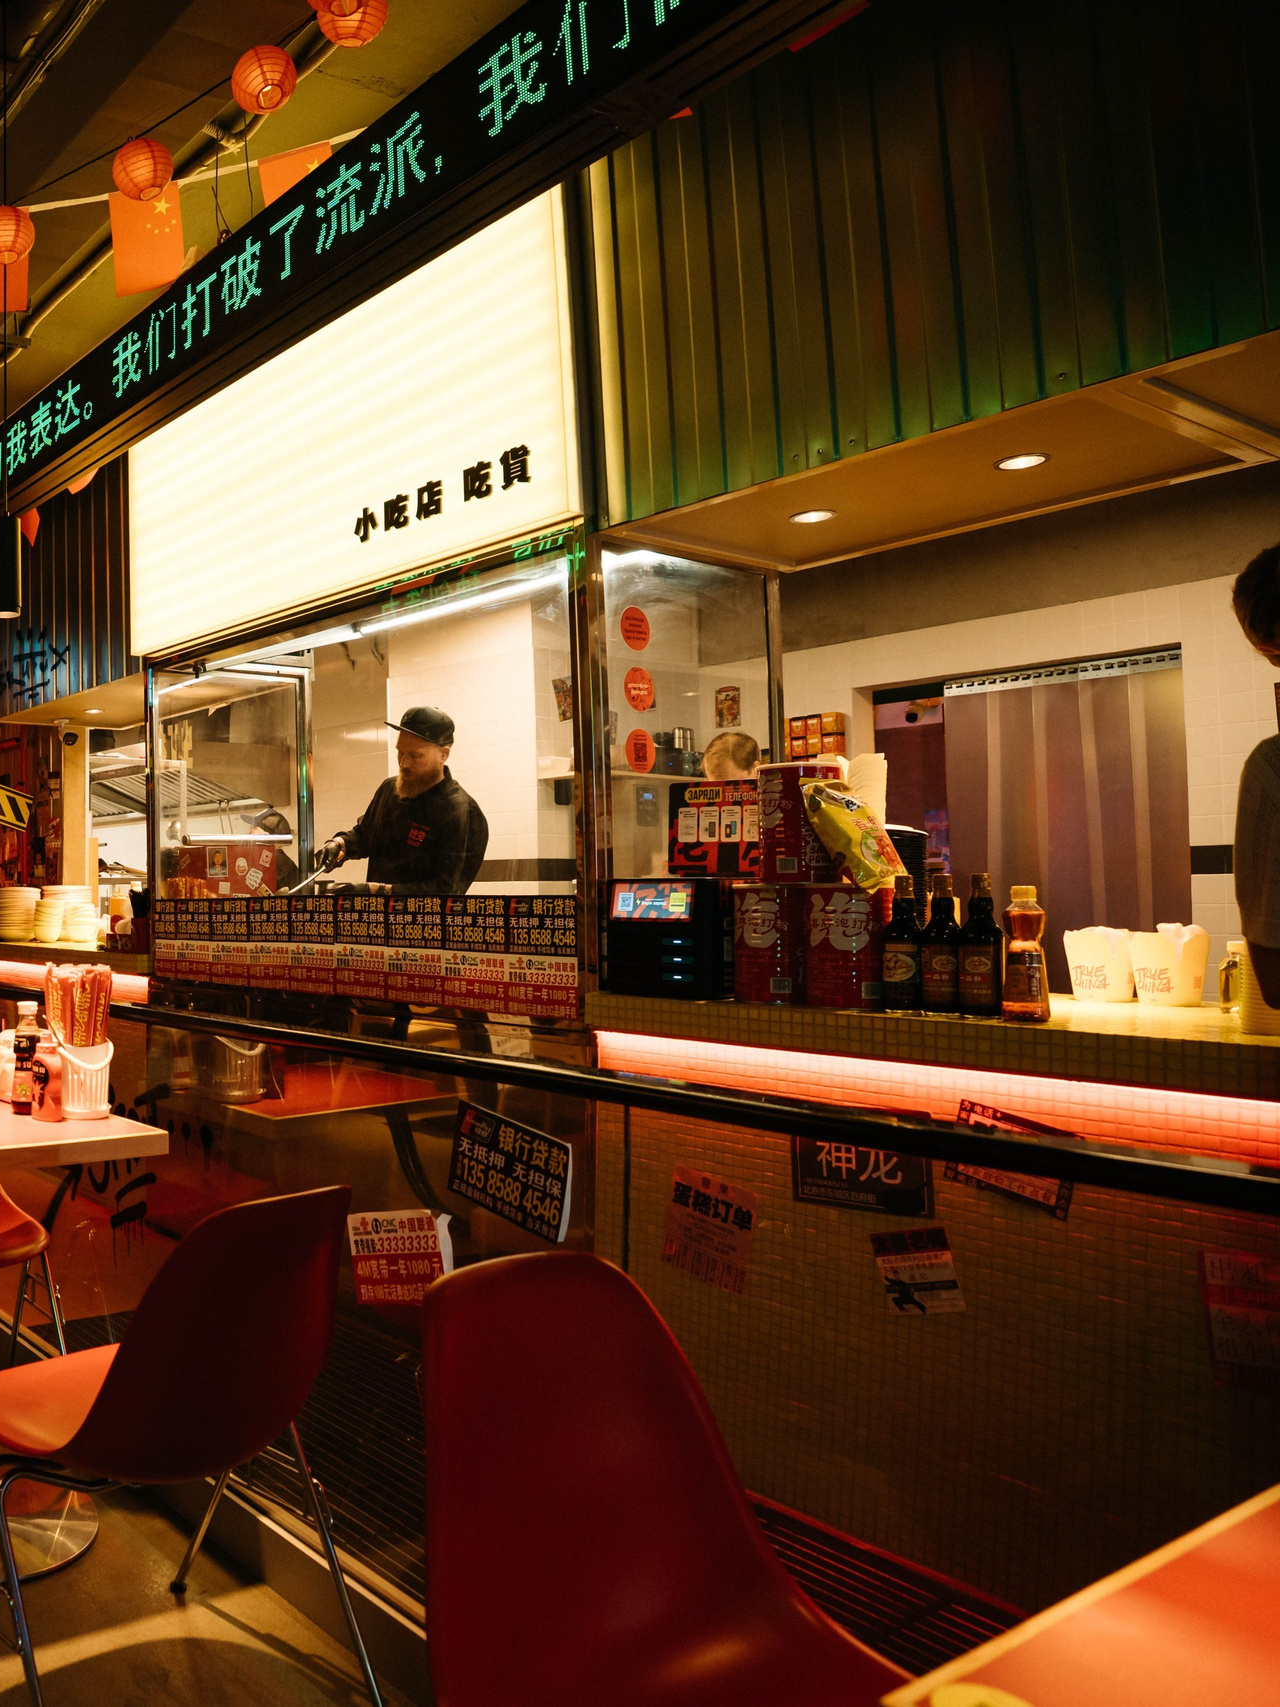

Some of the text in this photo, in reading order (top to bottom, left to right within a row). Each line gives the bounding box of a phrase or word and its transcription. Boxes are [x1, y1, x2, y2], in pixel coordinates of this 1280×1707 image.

[354, 480, 443, 543] 小吃店
[688, 789, 758, 801] ЗАРЯДИ ТЕЛЕФОН
[407, 898, 441, 912] 银行贷款
[466, 898, 504, 914] 银行贷款
[532, 898, 575, 916] 银行贷款
[388, 914, 441, 924] 无抵押 无担保
[445, 915, 504, 927] 无抵押 无担保
[509, 917, 575, 929] 无抵押 无担保
[340, 922, 384, 937] 135 8588 4546
[392, 925, 441, 940] 135 8588 4546
[449, 927, 505, 943] 135 8588 4546
[513, 929, 576, 946] 135 8588 4546
[547, 962, 575, 973] 中国联通
[1072, 965, 1107, 978] TRUE
[1135, 967, 1170, 980] TRUE
[498, 1123, 567, 1178] 银行贷款
[458, 1136, 506, 1170] 无抵押
[512, 1161, 562, 1198] 无担保
[463, 1157, 485, 1188] 135
[487, 1170, 522, 1206] 8588
[523, 1188, 560, 1226] 4546
[672, 1181, 754, 1231] 蛋糕订单
[399, 1216, 435, 1234] 中国联通
